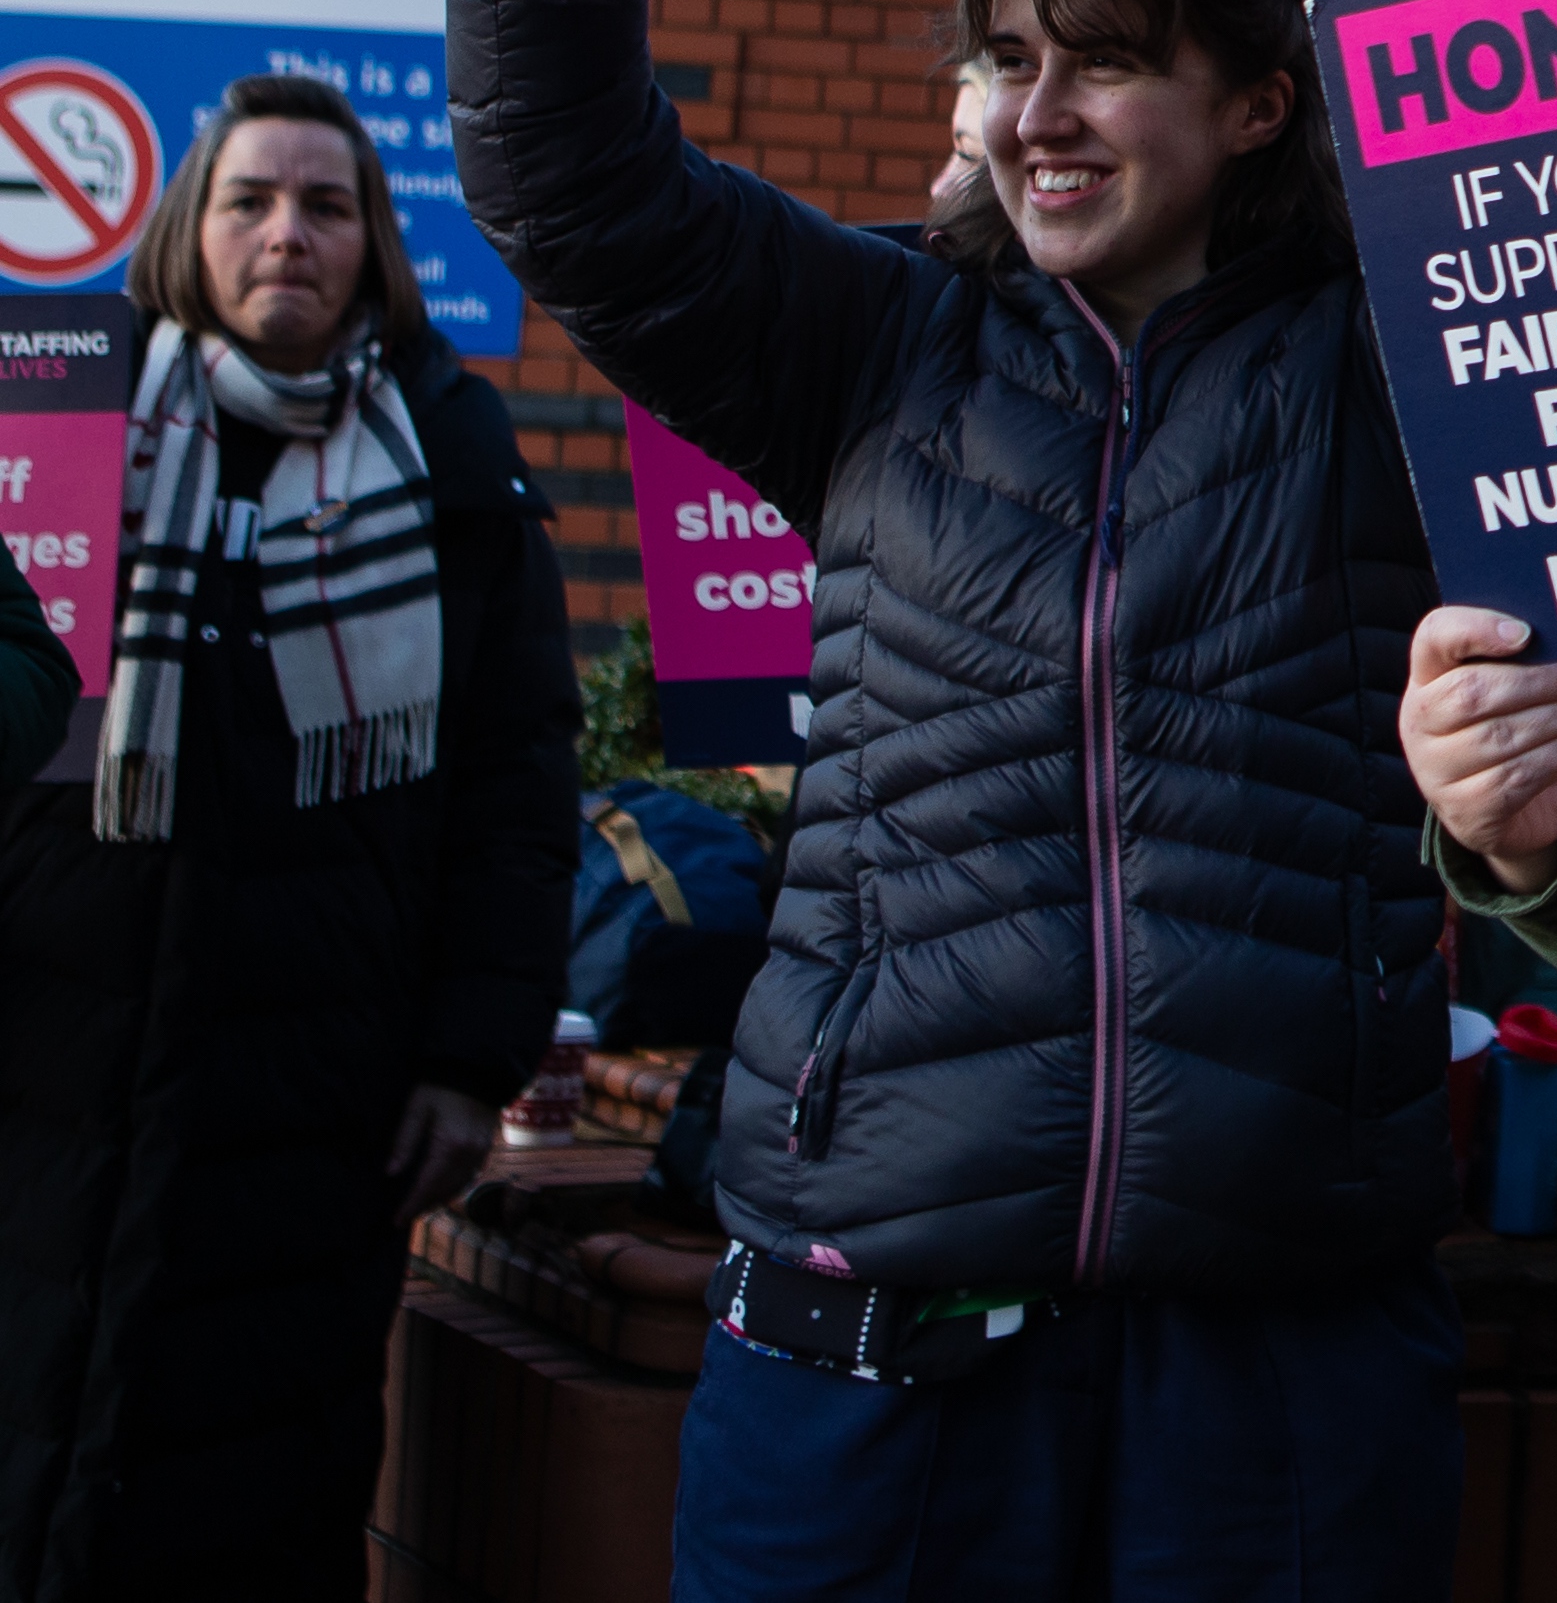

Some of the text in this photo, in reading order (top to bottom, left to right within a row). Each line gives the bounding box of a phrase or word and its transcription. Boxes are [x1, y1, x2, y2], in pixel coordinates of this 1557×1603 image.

[360, 50, 395, 97] is
[404, 62, 432, 97] a
[1453, 165, 1503, 231] IF
